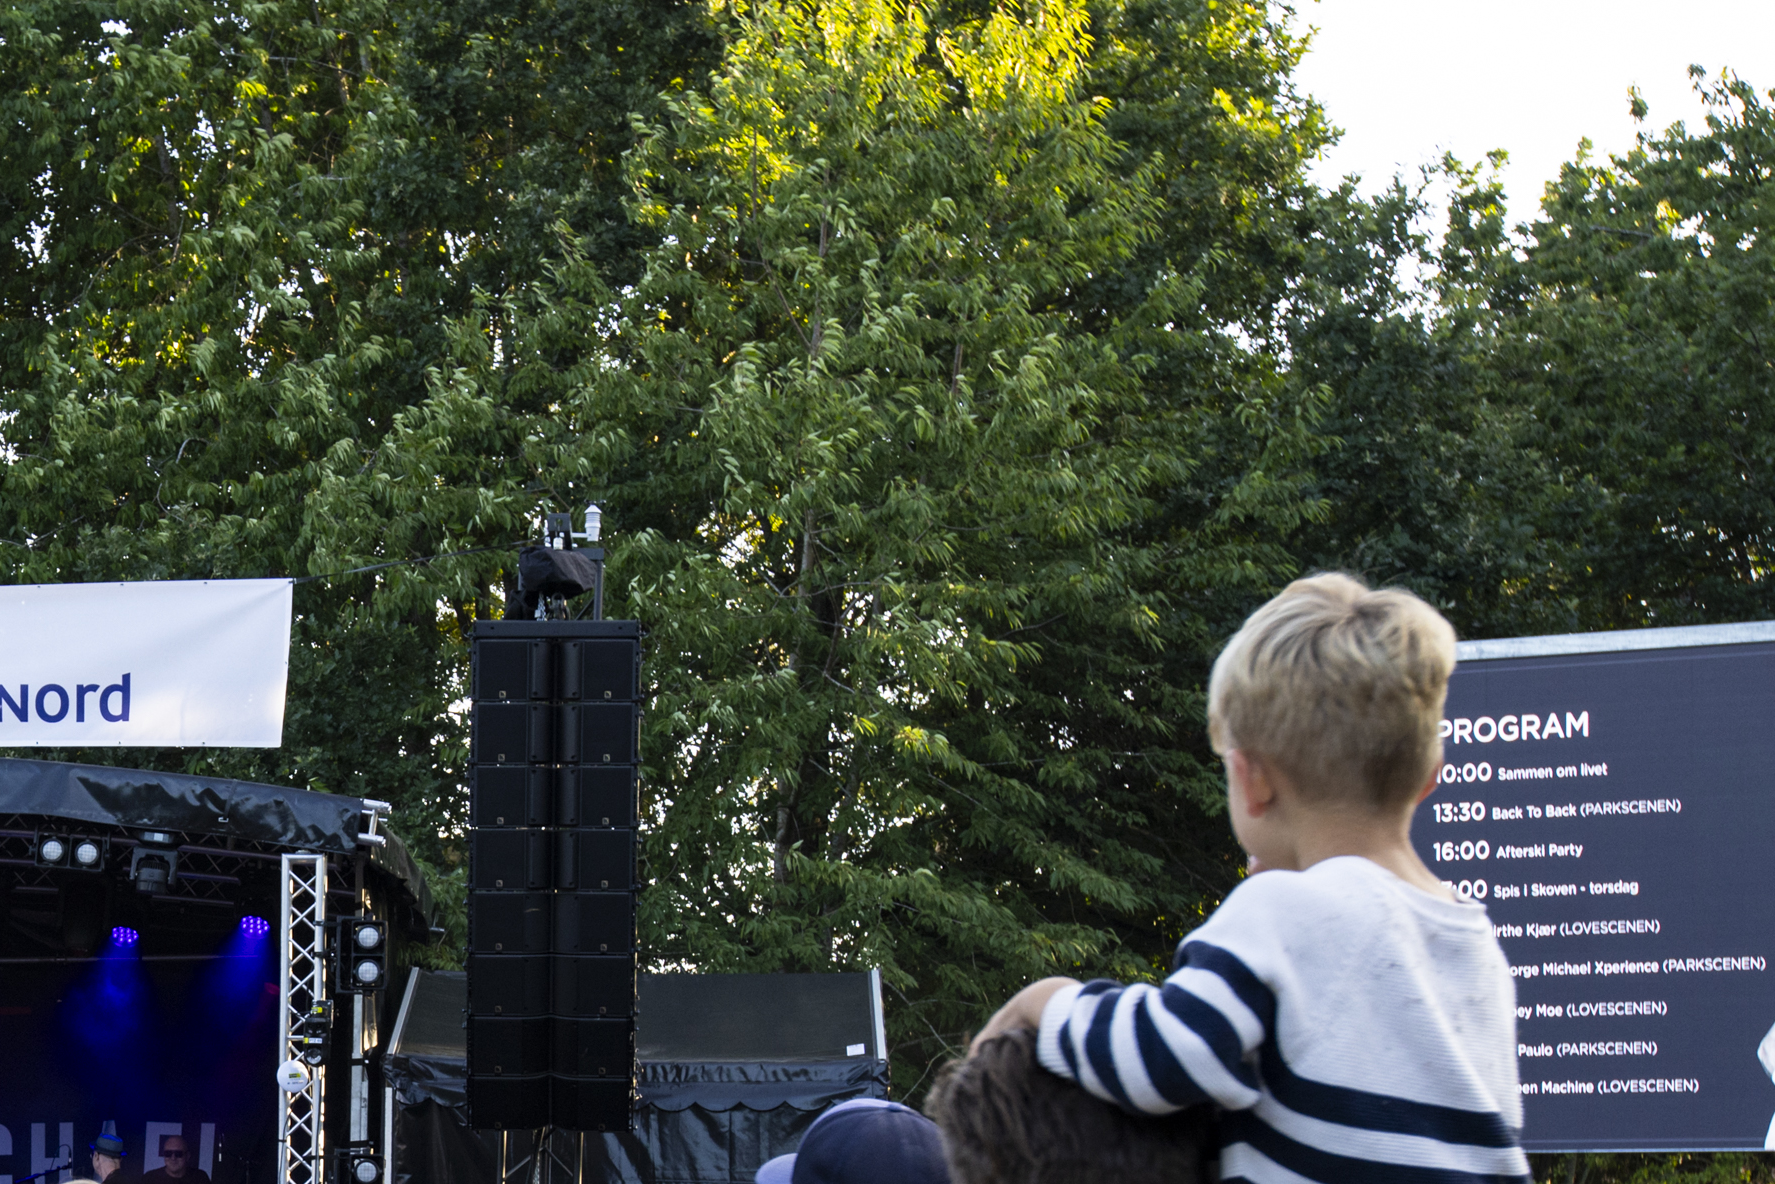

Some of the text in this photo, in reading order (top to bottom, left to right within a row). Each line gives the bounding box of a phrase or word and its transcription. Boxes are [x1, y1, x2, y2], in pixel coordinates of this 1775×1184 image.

[1436, 710, 1590, 745] PROGRAM
[1497, 766, 1553, 781] Sammen
[1555, 765, 1578, 778] om
[1580, 762, 1608, 777] livet
[1433, 798, 1682, 823] 13:30 Back To Back (PARKSCENEN)
[1433, 840, 1584, 862] 16:00 Afterski Party
[1493, 884, 1521, 900] Spis
[1531, 882, 1577, 897] Skoven
[1588, 879, 1640, 896] torsdag
[1492, 919, 1661, 939] irthe Kjær (LOVESCENEN)
[1509, 956, 1767, 979] orge Michael Xperience (PARKSCENEN)
[1536, 1003, 1563, 1017] Moe
[1566, 1001, 1668, 1018] (LOVESCENEN)
[1517, 1040, 1658, 1058] Paulo (PARKSCENEN)
[1541, 1079, 1595, 1095] Machine
[1597, 1078, 1700, 1096] (LOVESCENEN)
